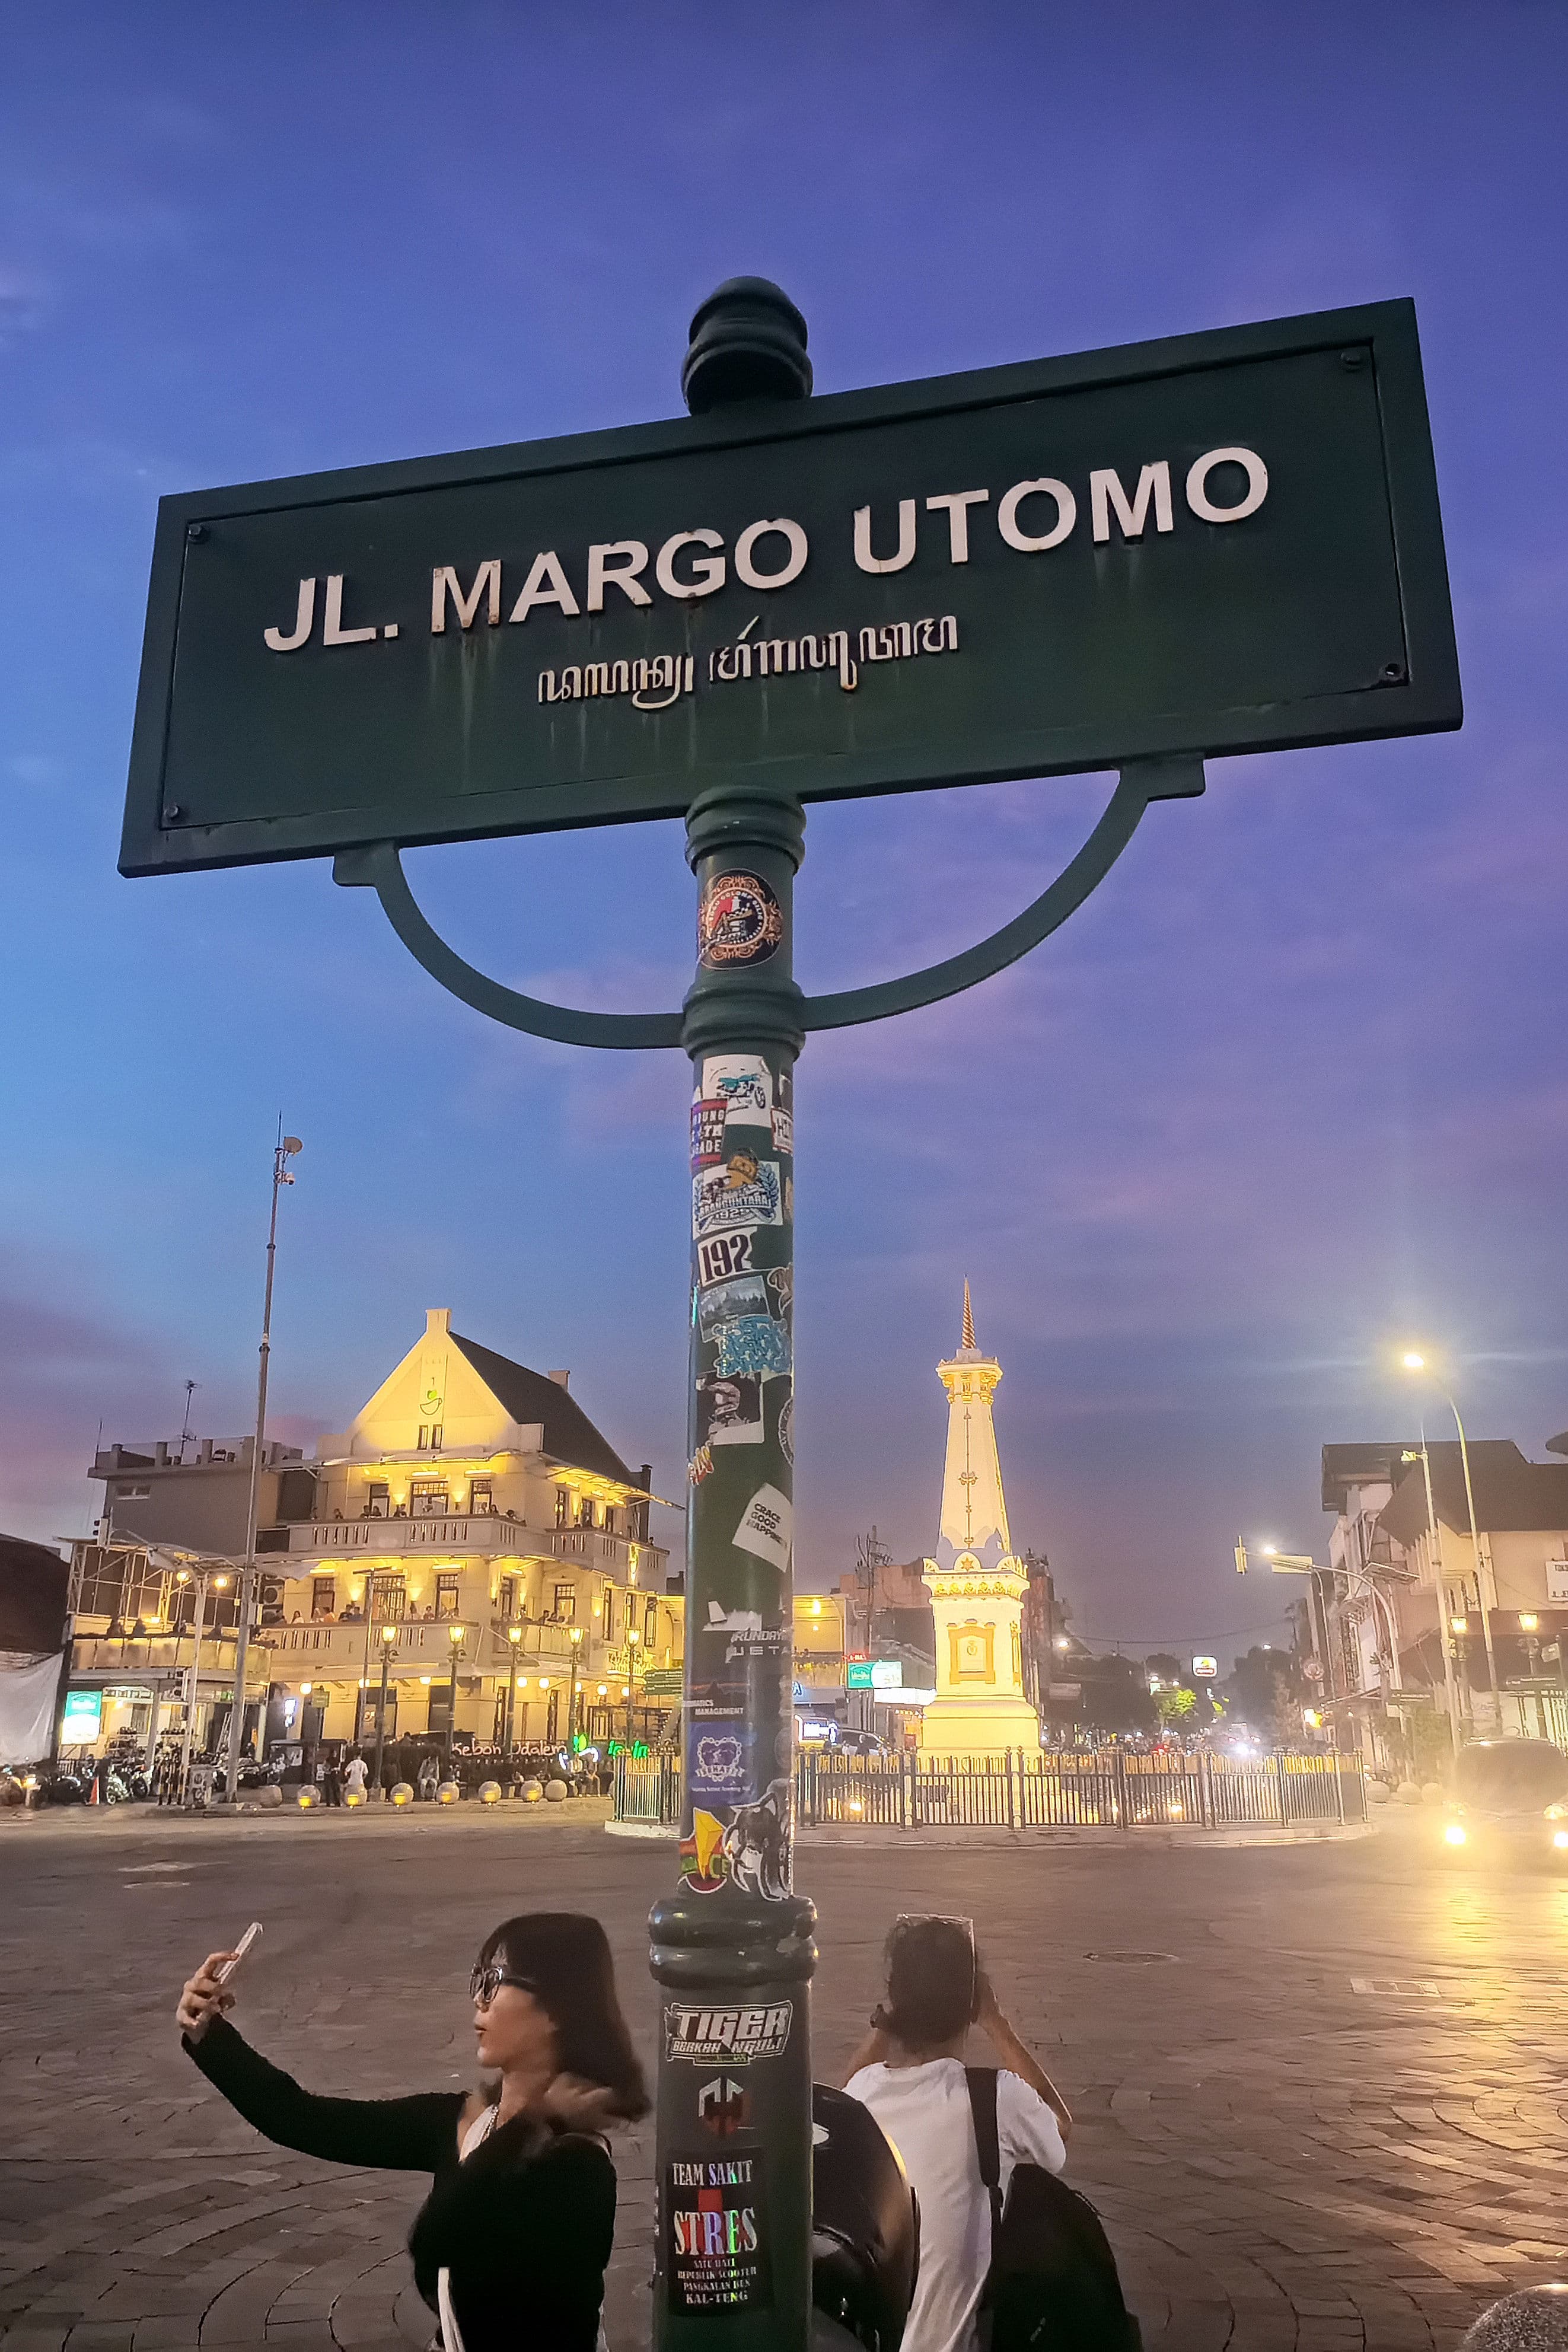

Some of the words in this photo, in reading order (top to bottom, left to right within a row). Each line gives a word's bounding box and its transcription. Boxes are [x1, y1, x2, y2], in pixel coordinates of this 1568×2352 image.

[264, 574, 399, 651] JL.
[431, 518, 809, 633] MARGO
[854, 447, 1269, 573] UTOMO
[700, 1234, 751, 1283] 192
[451, 1737, 502, 1757] Kebon
[675, 2007, 789, 2050] TIGER
[672, 2162, 705, 2186] TEAM
[708, 2159, 753, 2186] SAKIT
[673, 2207, 758, 2255] STRES
[686, 2290, 748, 2305] KAL-TENG
